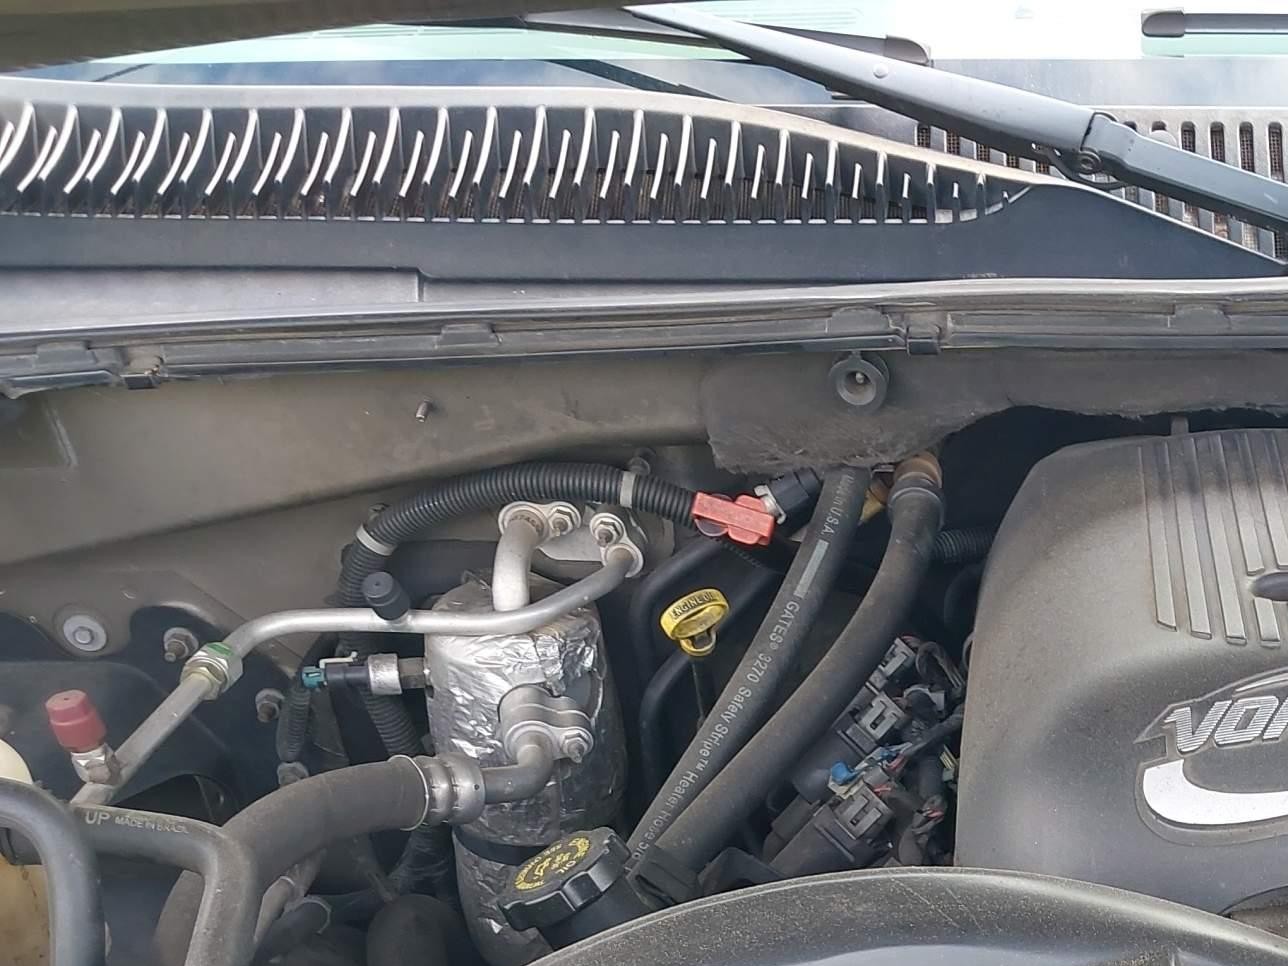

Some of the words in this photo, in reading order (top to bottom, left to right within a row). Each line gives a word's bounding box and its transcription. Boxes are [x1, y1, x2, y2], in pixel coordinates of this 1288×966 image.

[821, 507, 843, 535] U.S.A.
[672, 596, 704, 620] ENGINE
[747, 653, 772, 683] 3270
[720, 686, 752, 723] Safety
[665, 770, 699, 809] Heater
[85, 811, 110, 825] UP
[115, 816, 144, 829] MADE
[644, 810, 672, 840] Hose
